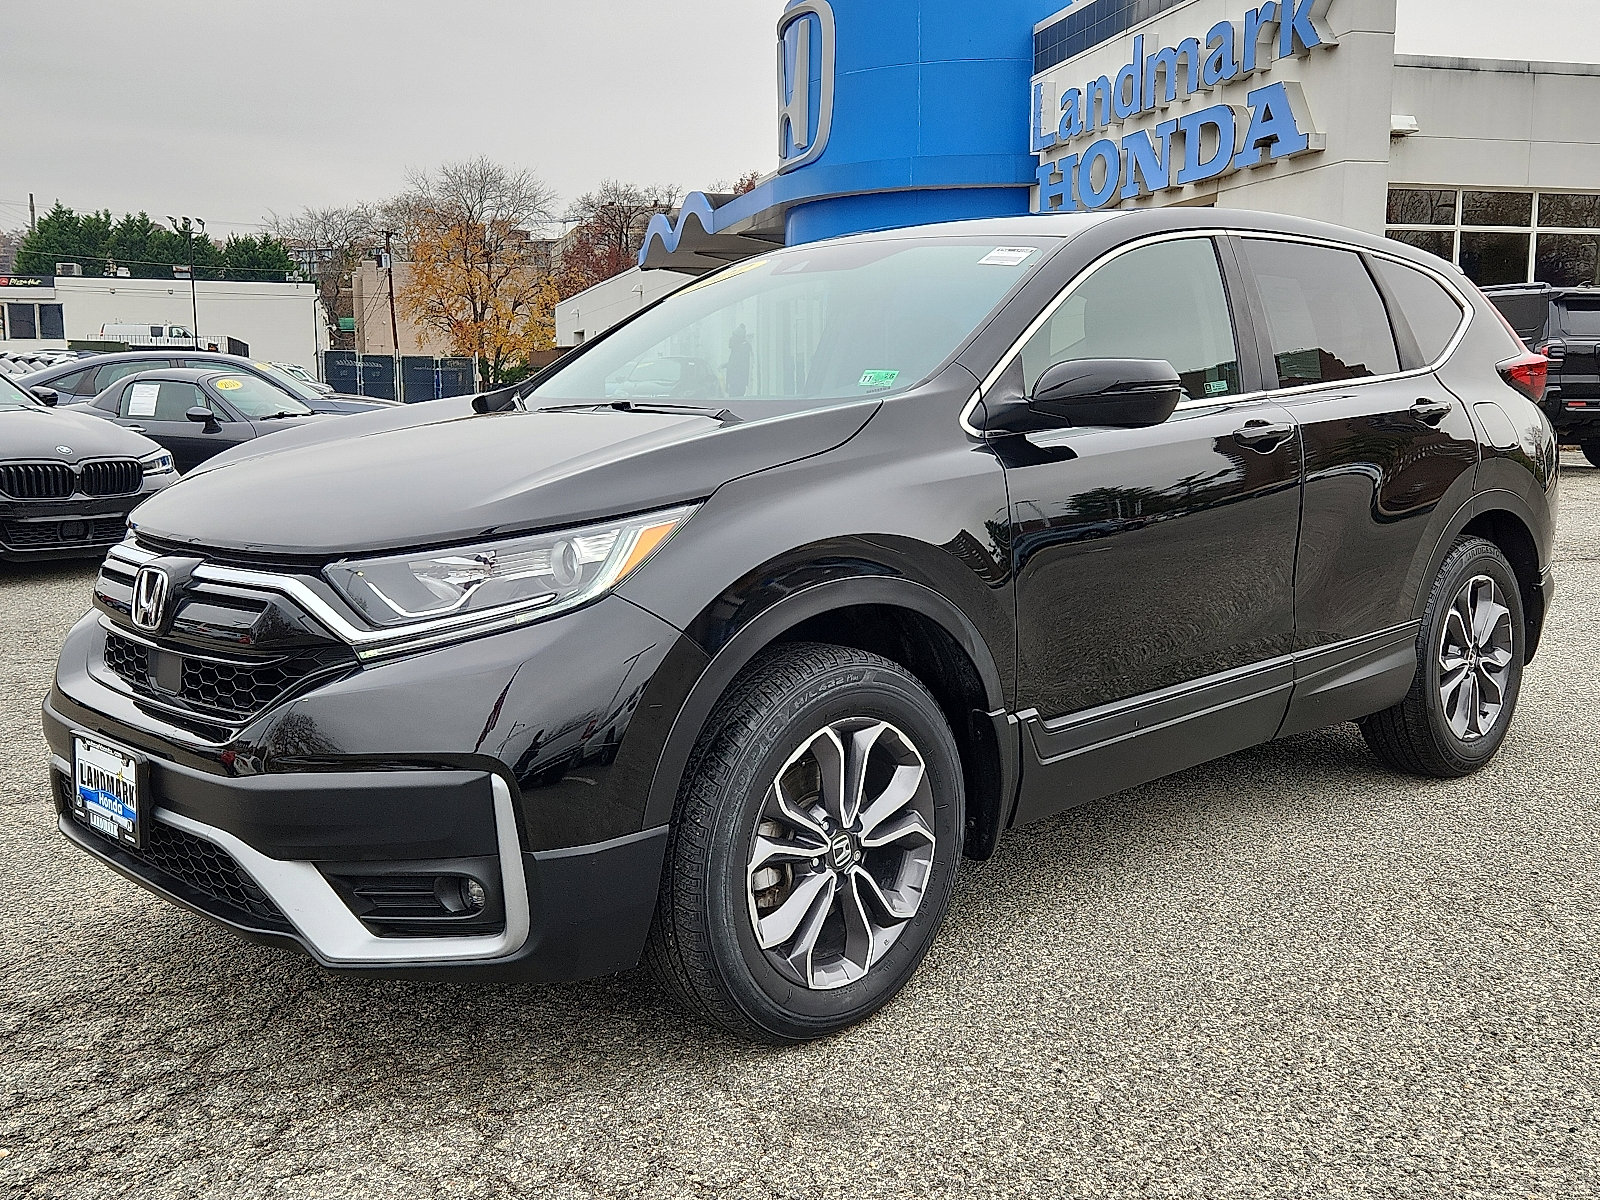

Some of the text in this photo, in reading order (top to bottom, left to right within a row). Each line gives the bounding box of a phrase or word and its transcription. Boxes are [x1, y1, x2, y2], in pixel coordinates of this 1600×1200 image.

[1033, 0, 1322, 152] Landmark
[1036, 80, 1309, 211] HONDA
[80, 762, 136, 810] LANDMARK
[98, 792, 123, 816] Honda
